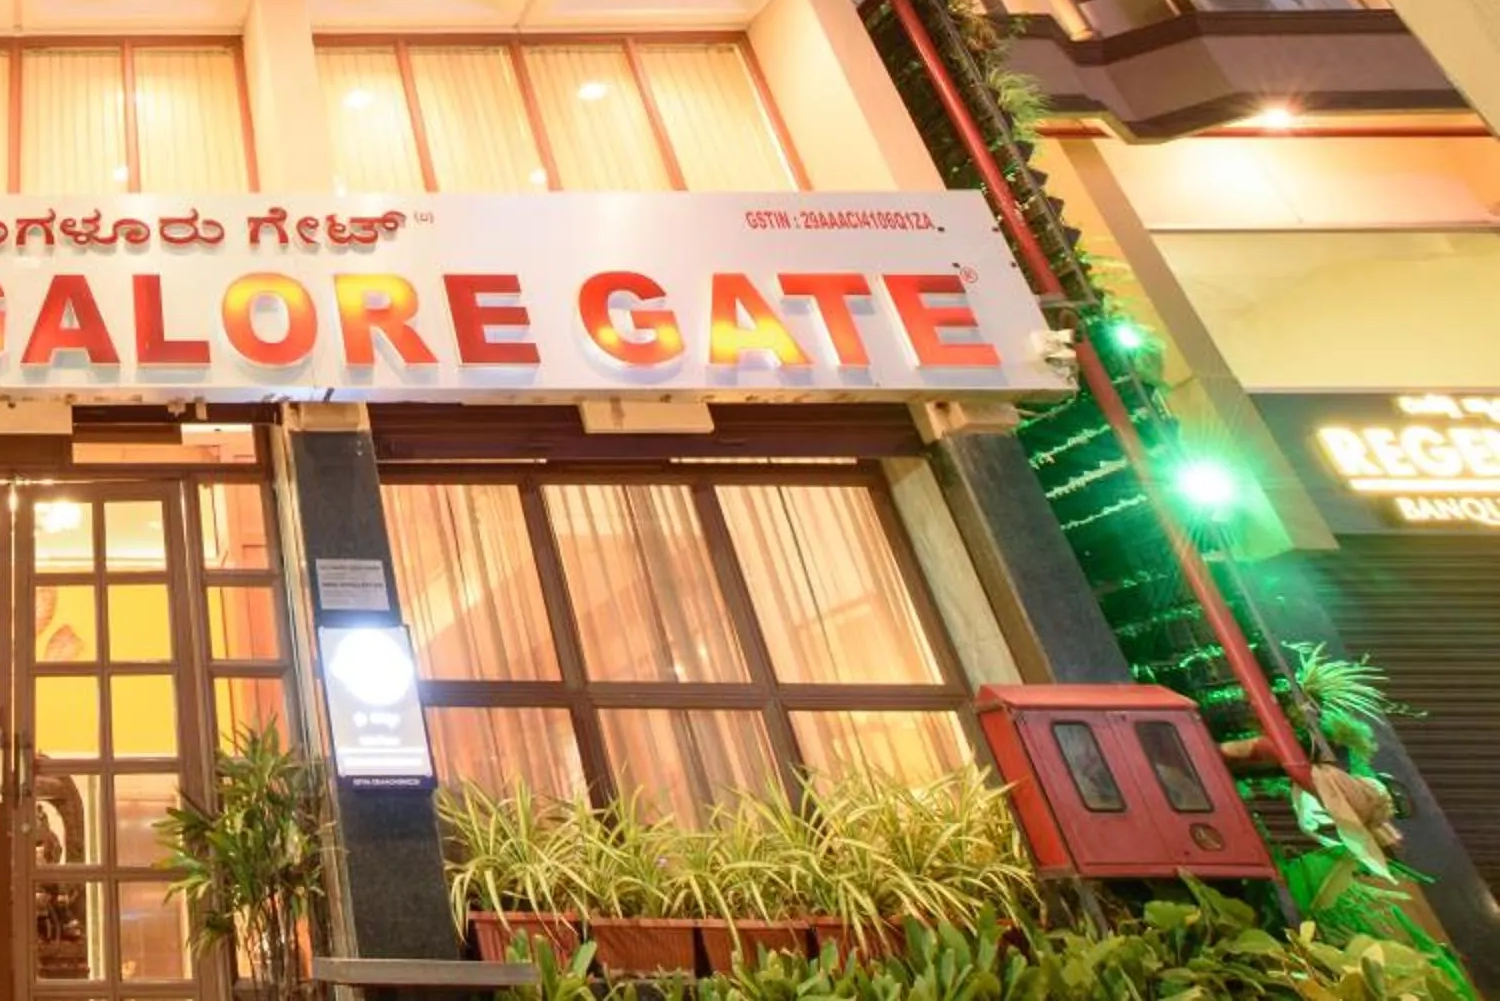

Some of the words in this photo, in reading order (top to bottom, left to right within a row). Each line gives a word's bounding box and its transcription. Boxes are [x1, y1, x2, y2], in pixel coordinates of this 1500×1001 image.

[246, 206, 407, 245] ಗೇಟ್
[744, 210, 792, 230] GSTIN
[578, 270, 1002, 369] GATE
[1317, 425, 1500, 477] REGE
